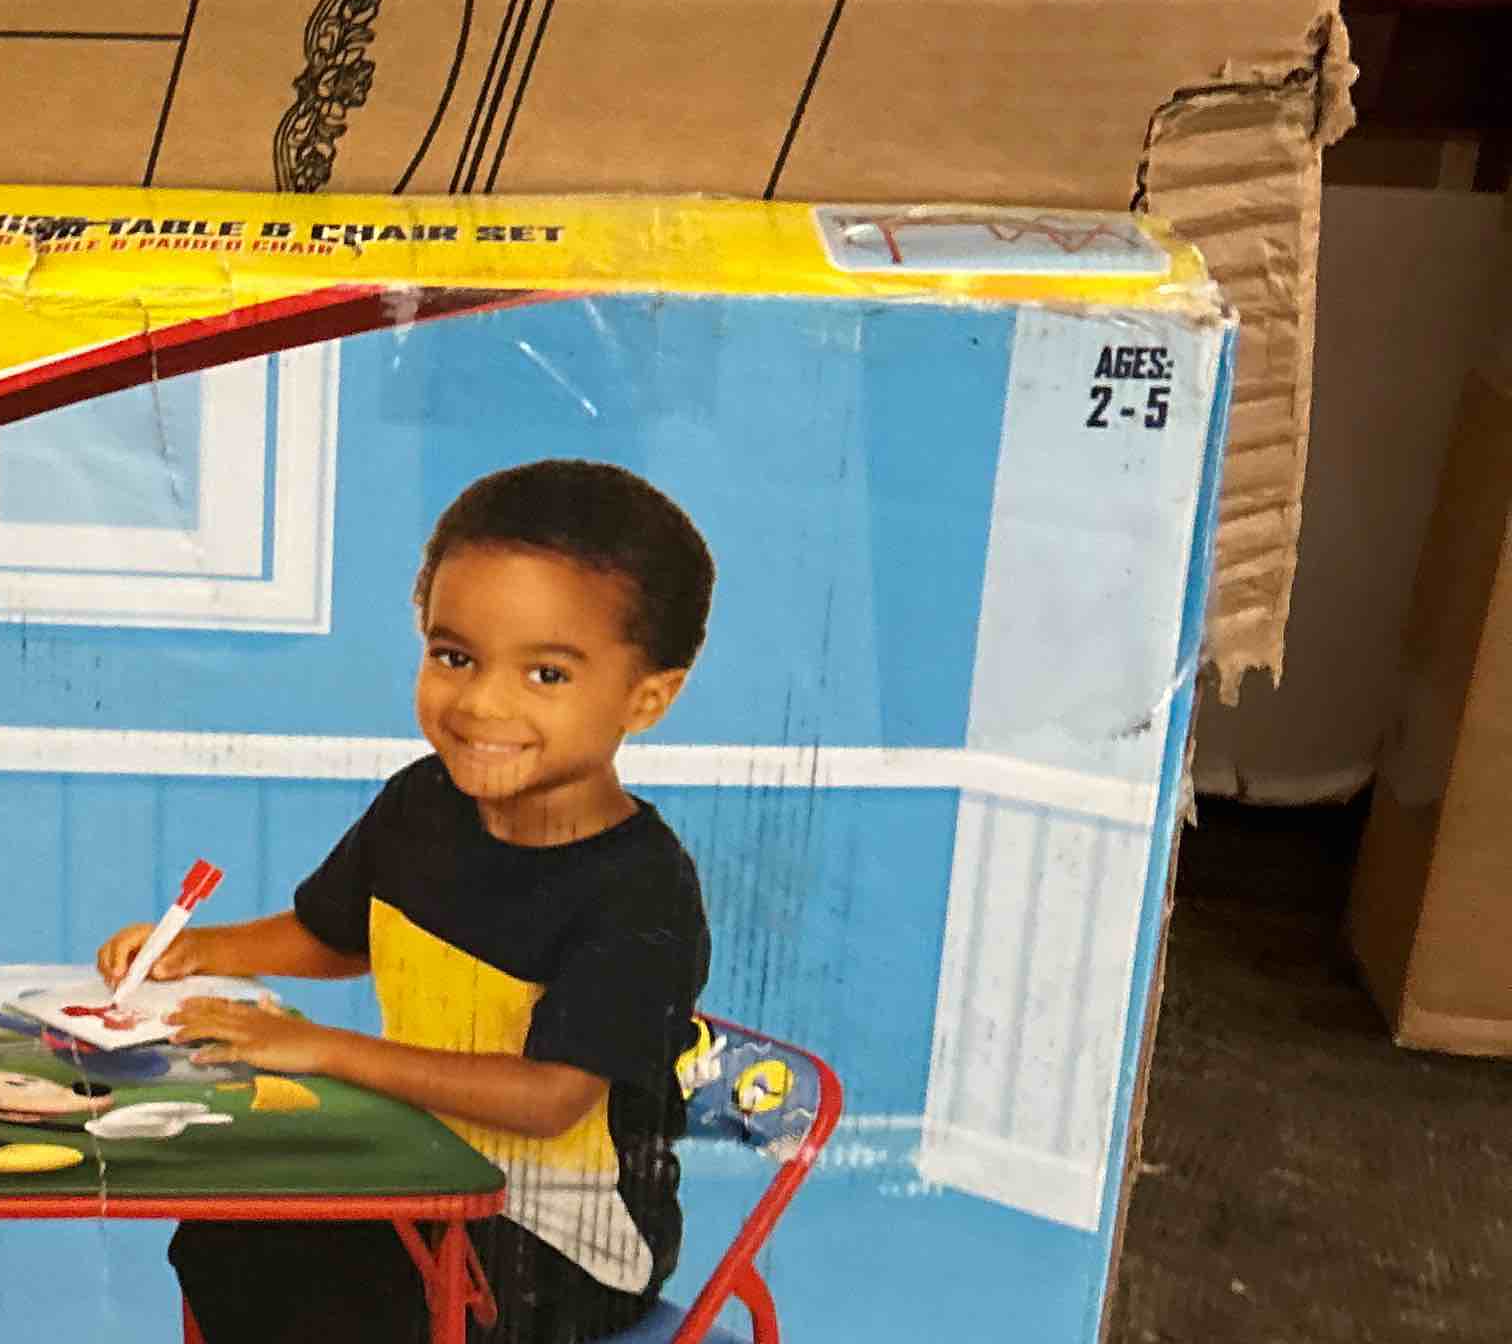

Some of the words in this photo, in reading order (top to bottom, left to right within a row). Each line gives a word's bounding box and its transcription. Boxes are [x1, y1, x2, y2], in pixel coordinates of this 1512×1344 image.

[106, 217, 247, 238] TABLE
[310, 223, 459, 246] CHAIR
[475, 224, 566, 242] SET
[1094, 346, 1175, 381] AGES:
